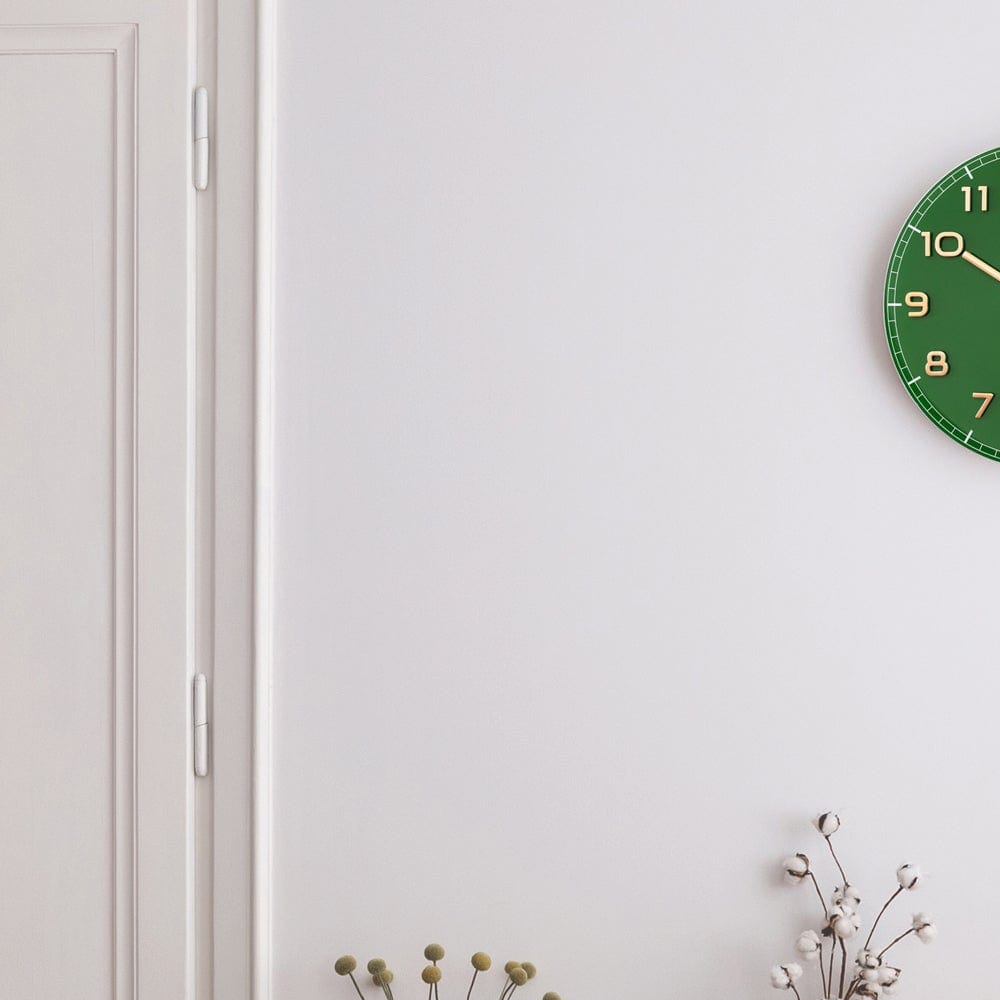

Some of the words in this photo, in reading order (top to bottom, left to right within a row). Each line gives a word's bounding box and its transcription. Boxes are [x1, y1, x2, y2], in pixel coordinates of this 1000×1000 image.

[961, 186, 988, 212] 11
[921, 231, 964, 257] 10
[904, 291, 929, 318] 9
[924, 350, 949, 377] 8
[972, 392, 994, 418] 7
